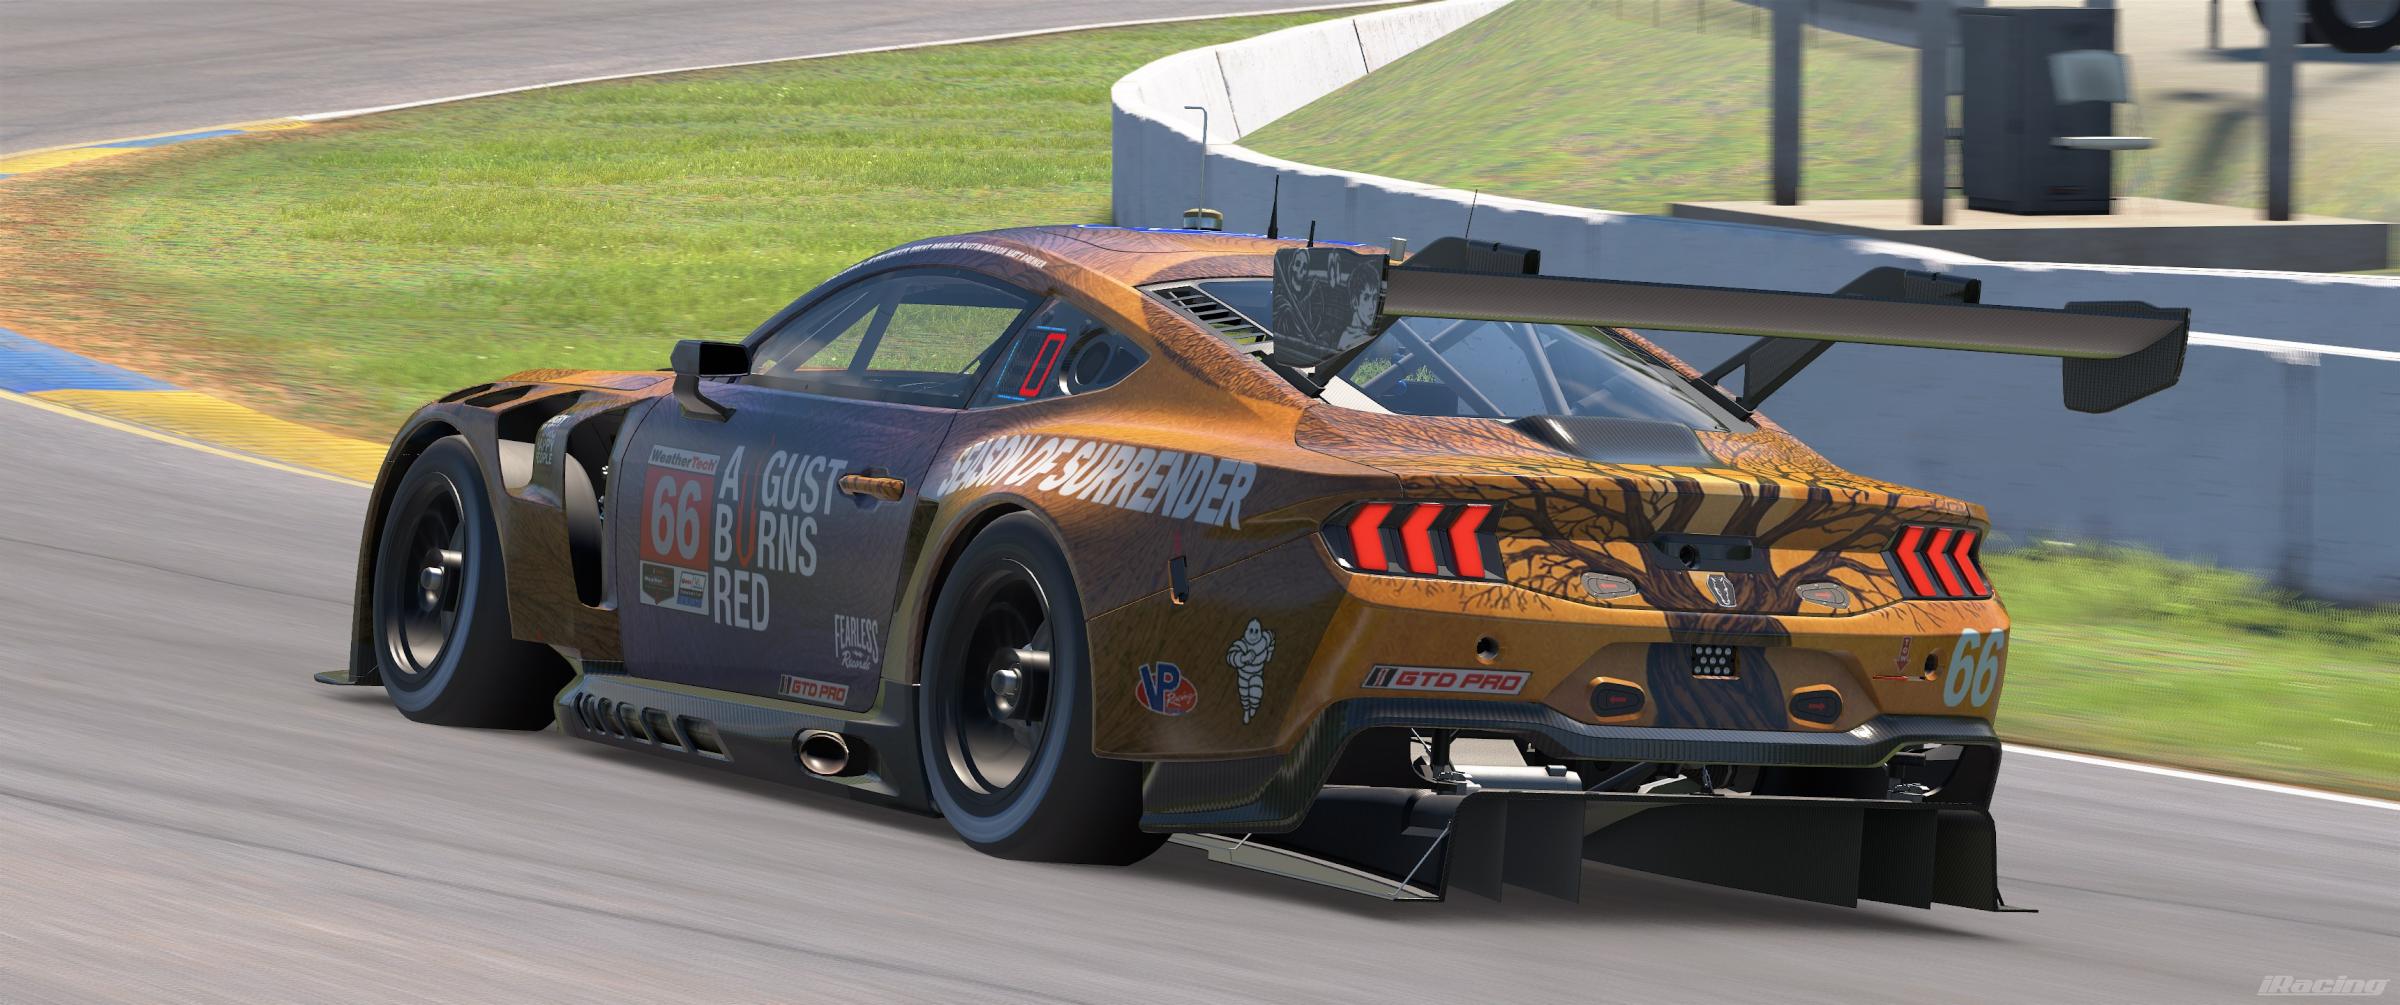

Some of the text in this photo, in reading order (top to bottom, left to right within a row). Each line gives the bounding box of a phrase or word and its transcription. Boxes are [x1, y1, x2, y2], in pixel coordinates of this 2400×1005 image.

[651, 448, 718, 473] WeatherTech
[937, 434, 1257, 530] SEASON OF SURRENDER
[651, 474, 702, 561] 66
[714, 503, 818, 577] BURNS
[713, 565, 770, 632] RED
[834, 613, 879, 664] FEARLESS
[1944, 628, 2004, 707] 66
[791, 678, 847, 702] GTD PRO
[1138, 661, 1181, 714] VP
[1395, 670, 1523, 692] GTD PRO
